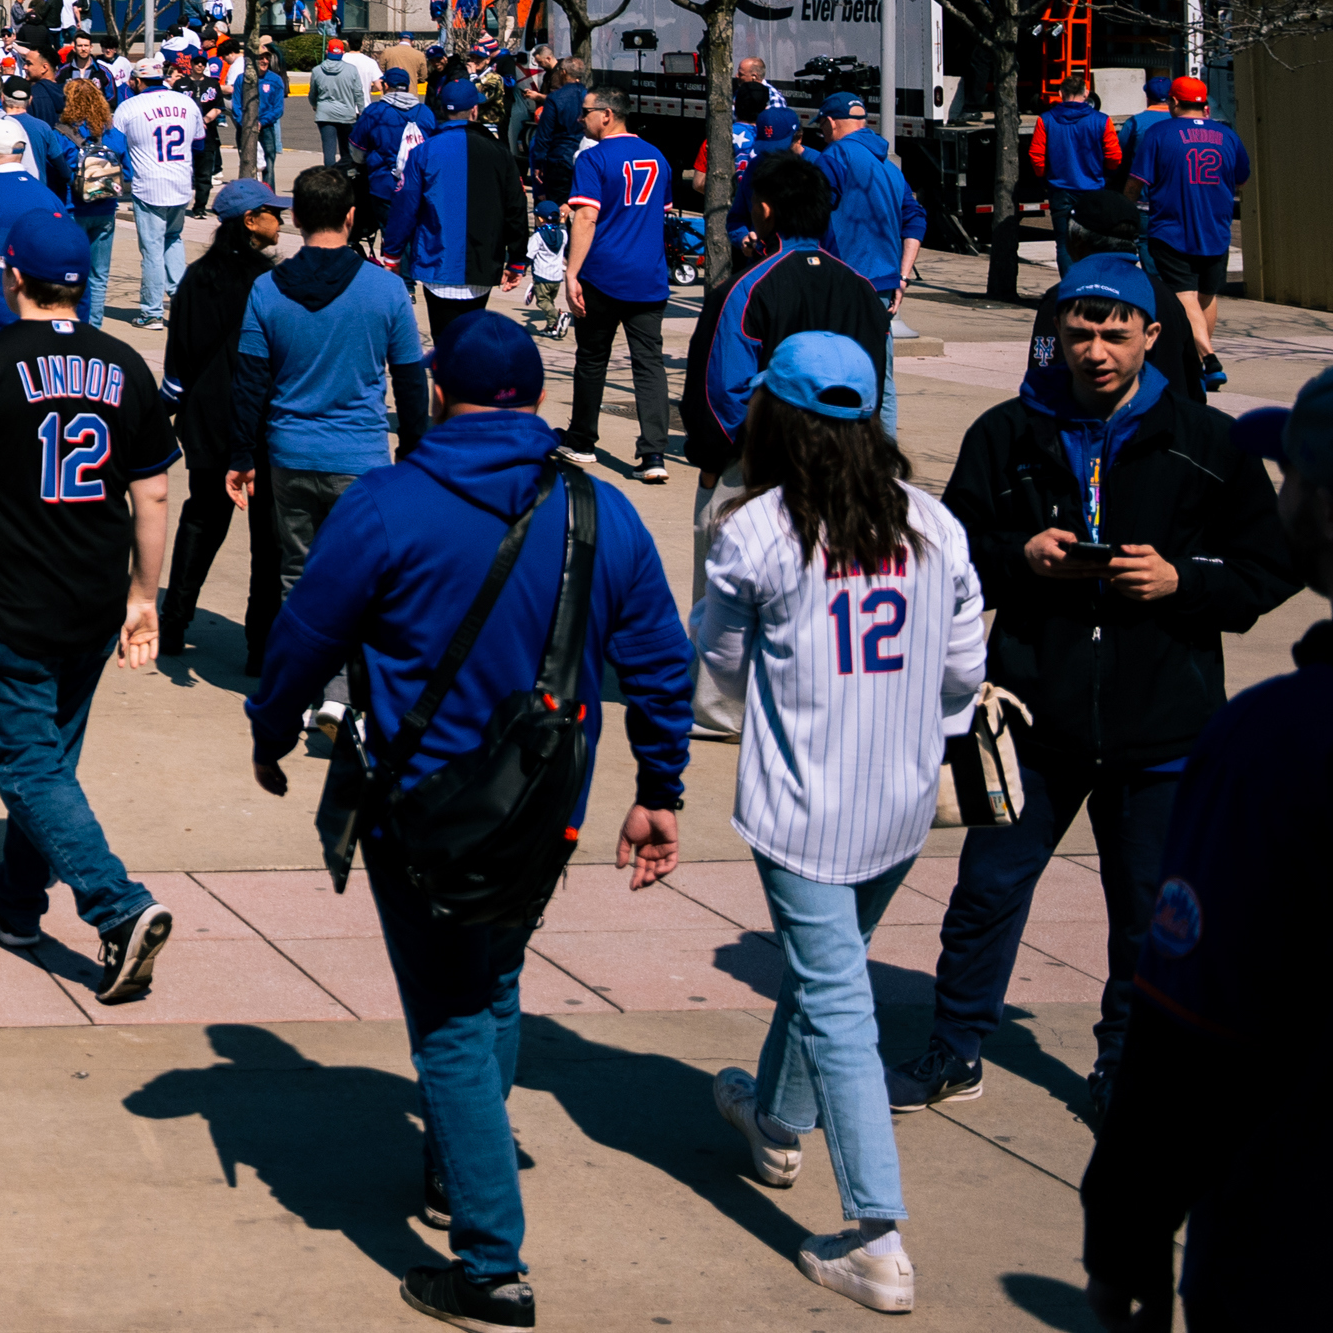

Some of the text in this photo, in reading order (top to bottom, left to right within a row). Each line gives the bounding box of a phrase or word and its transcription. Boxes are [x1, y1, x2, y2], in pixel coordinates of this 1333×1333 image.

[143, 106, 188, 122] LINDOR
[152, 124, 186, 163] 12
[1179, 128, 1224, 146] LINDOR
[622, 159, 660, 206] 17
[1185, 148, 1223, 185] 12
[1100, 284, 1120, 295] COACH
[1033, 335, 1056, 367] NY
[16, 355, 126, 408] LINDOR
[38, 412, 111, 504] 12
[828, 587, 908, 676] 12
